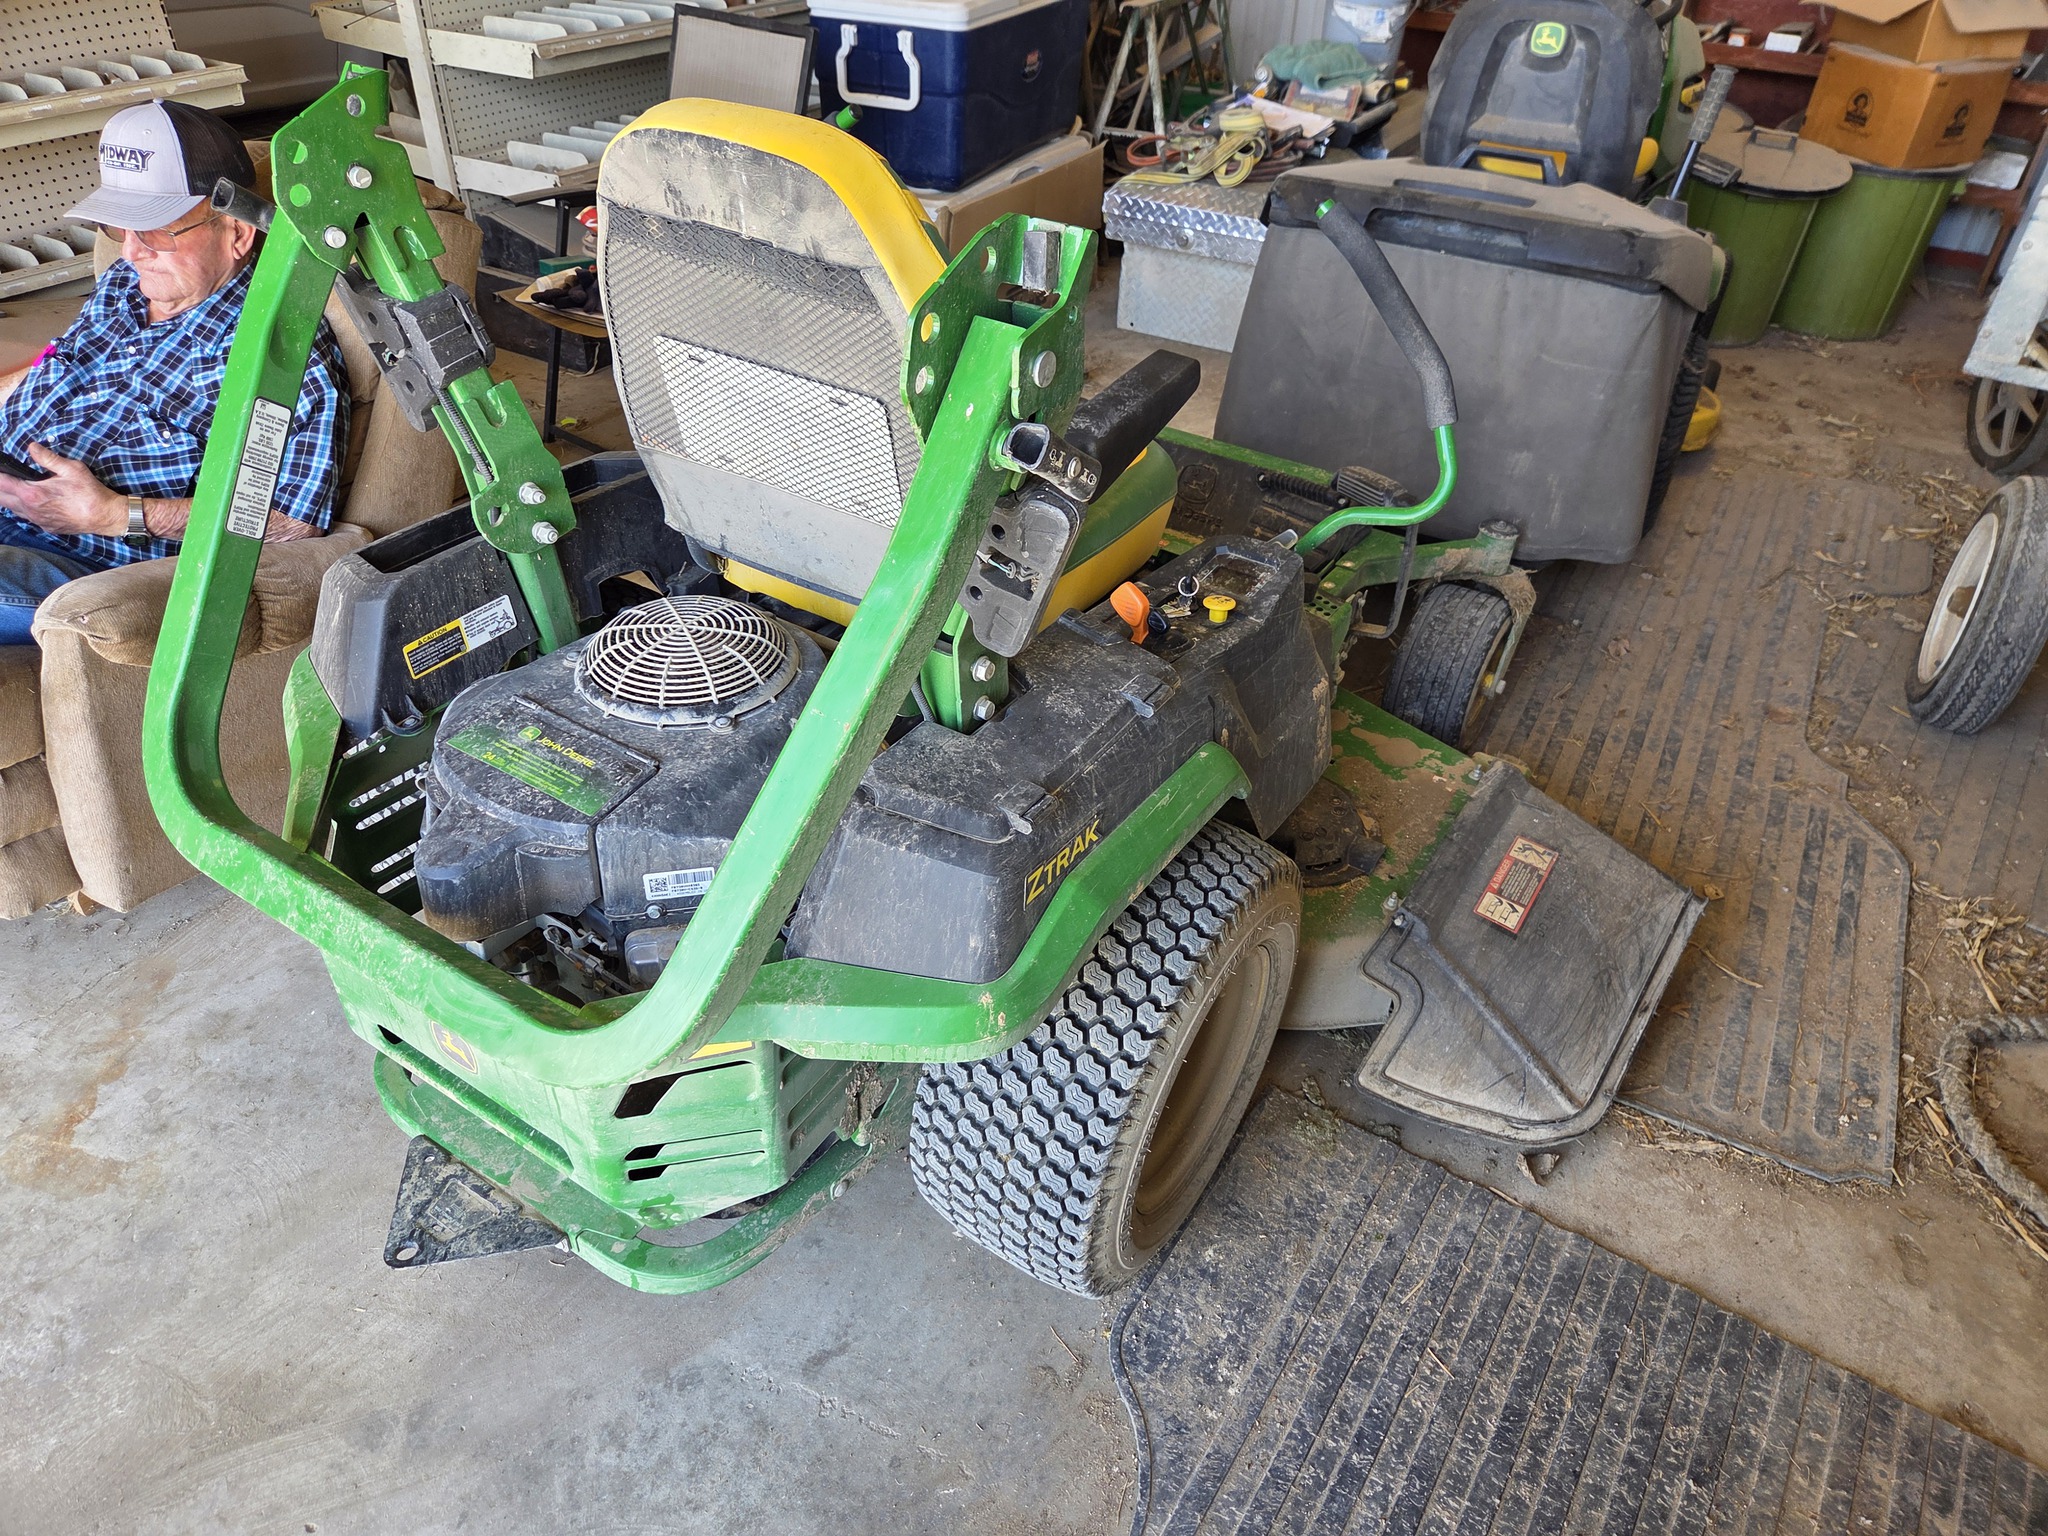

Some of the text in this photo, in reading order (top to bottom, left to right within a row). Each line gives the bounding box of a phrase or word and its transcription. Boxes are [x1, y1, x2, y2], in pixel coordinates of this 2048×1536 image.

[100, 144, 152, 169] MIDWAY
[233, 520, 258, 531] PROTECTIVE
[234, 515, 259, 526] STRUCTURE
[422, 626, 447, 642] CAUTION
[481, 750, 496, 761] 24
[538, 736, 564, 751] JOHN
[562, 747, 596, 768] DEERE
[1026, 819, 1100, 905] ZTRAK
[1492, 858, 1511, 883] DANGER
